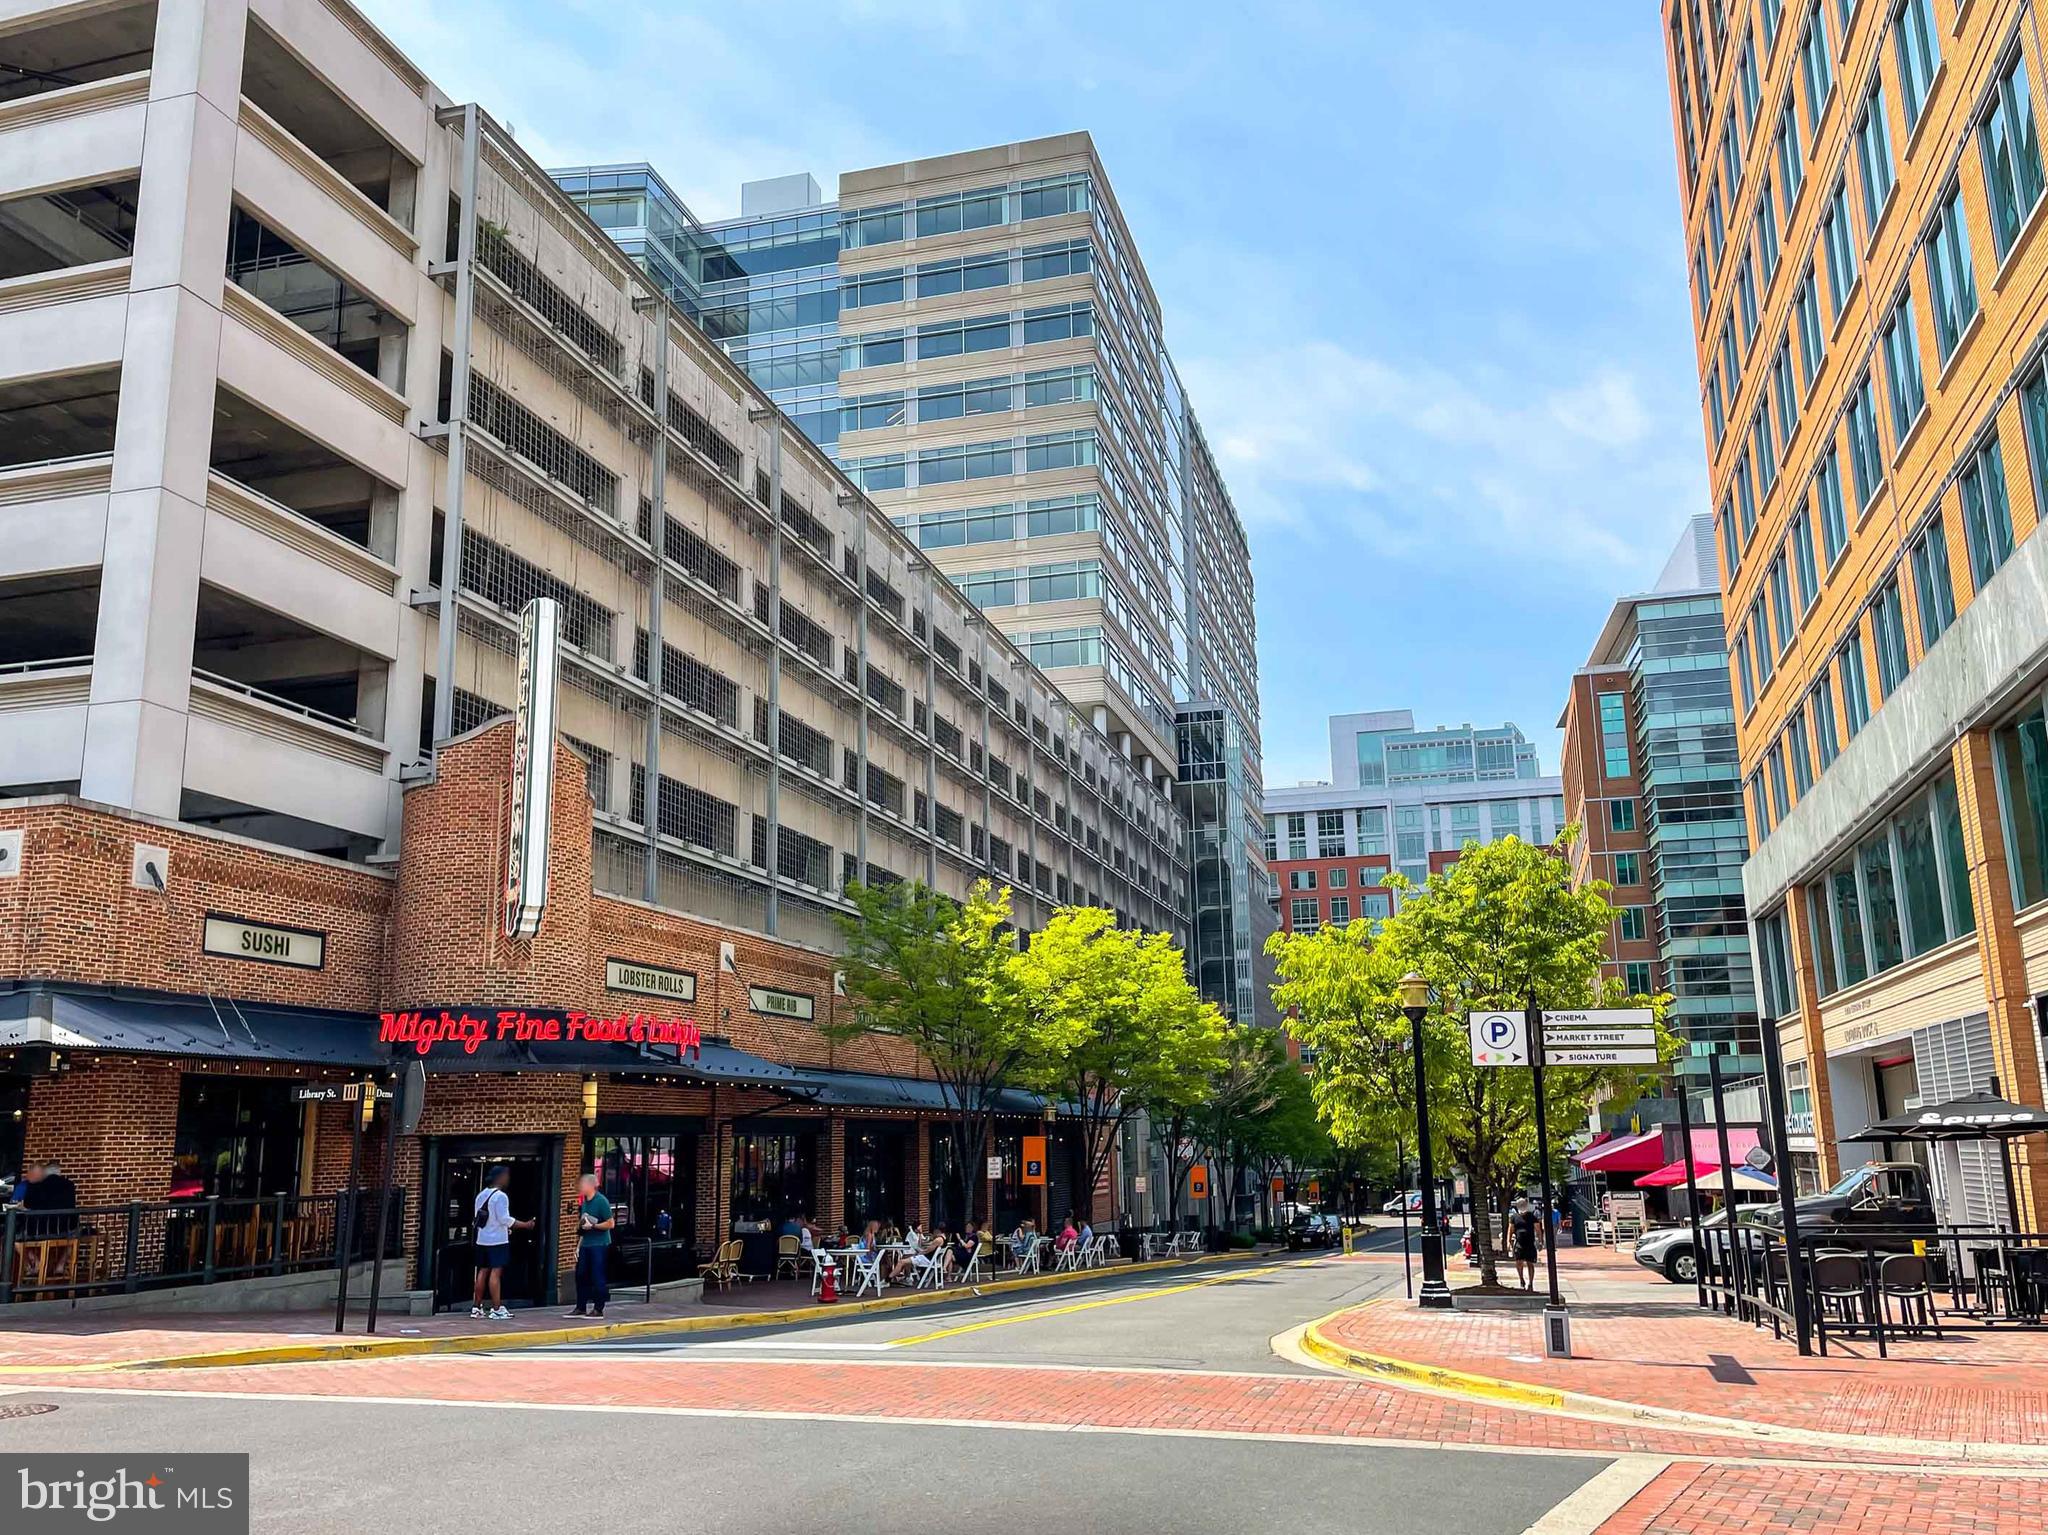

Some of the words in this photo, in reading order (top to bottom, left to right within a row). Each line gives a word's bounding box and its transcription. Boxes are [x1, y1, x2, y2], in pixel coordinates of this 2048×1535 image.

[241, 930, 290, 956] SUSHI
[618, 968, 656, 990] LOBSTER
[658, 975, 684, 994] ROLLS
[766, 994, 785, 1008] PRIME
[1555, 1014, 1588, 1022] CINEMA
[379, 1012, 488, 1055] Mighty
[497, 1012, 560, 1041] Fine
[567, 1011, 628, 1042] Food
[631, 1014, 645, 1042] &
[1491, 1022, 1508, 1043] P
[1556, 1034, 1590, 1042] MARKET
[1593, 1033, 1625, 1041] STREET
[1569, 1053, 1617, 1061] SIGNATURE
[299, 1089, 326, 1100] Library
[326, 1088, 337, 1098] St.
[1917, 1112, 2034, 1126] &pizza
